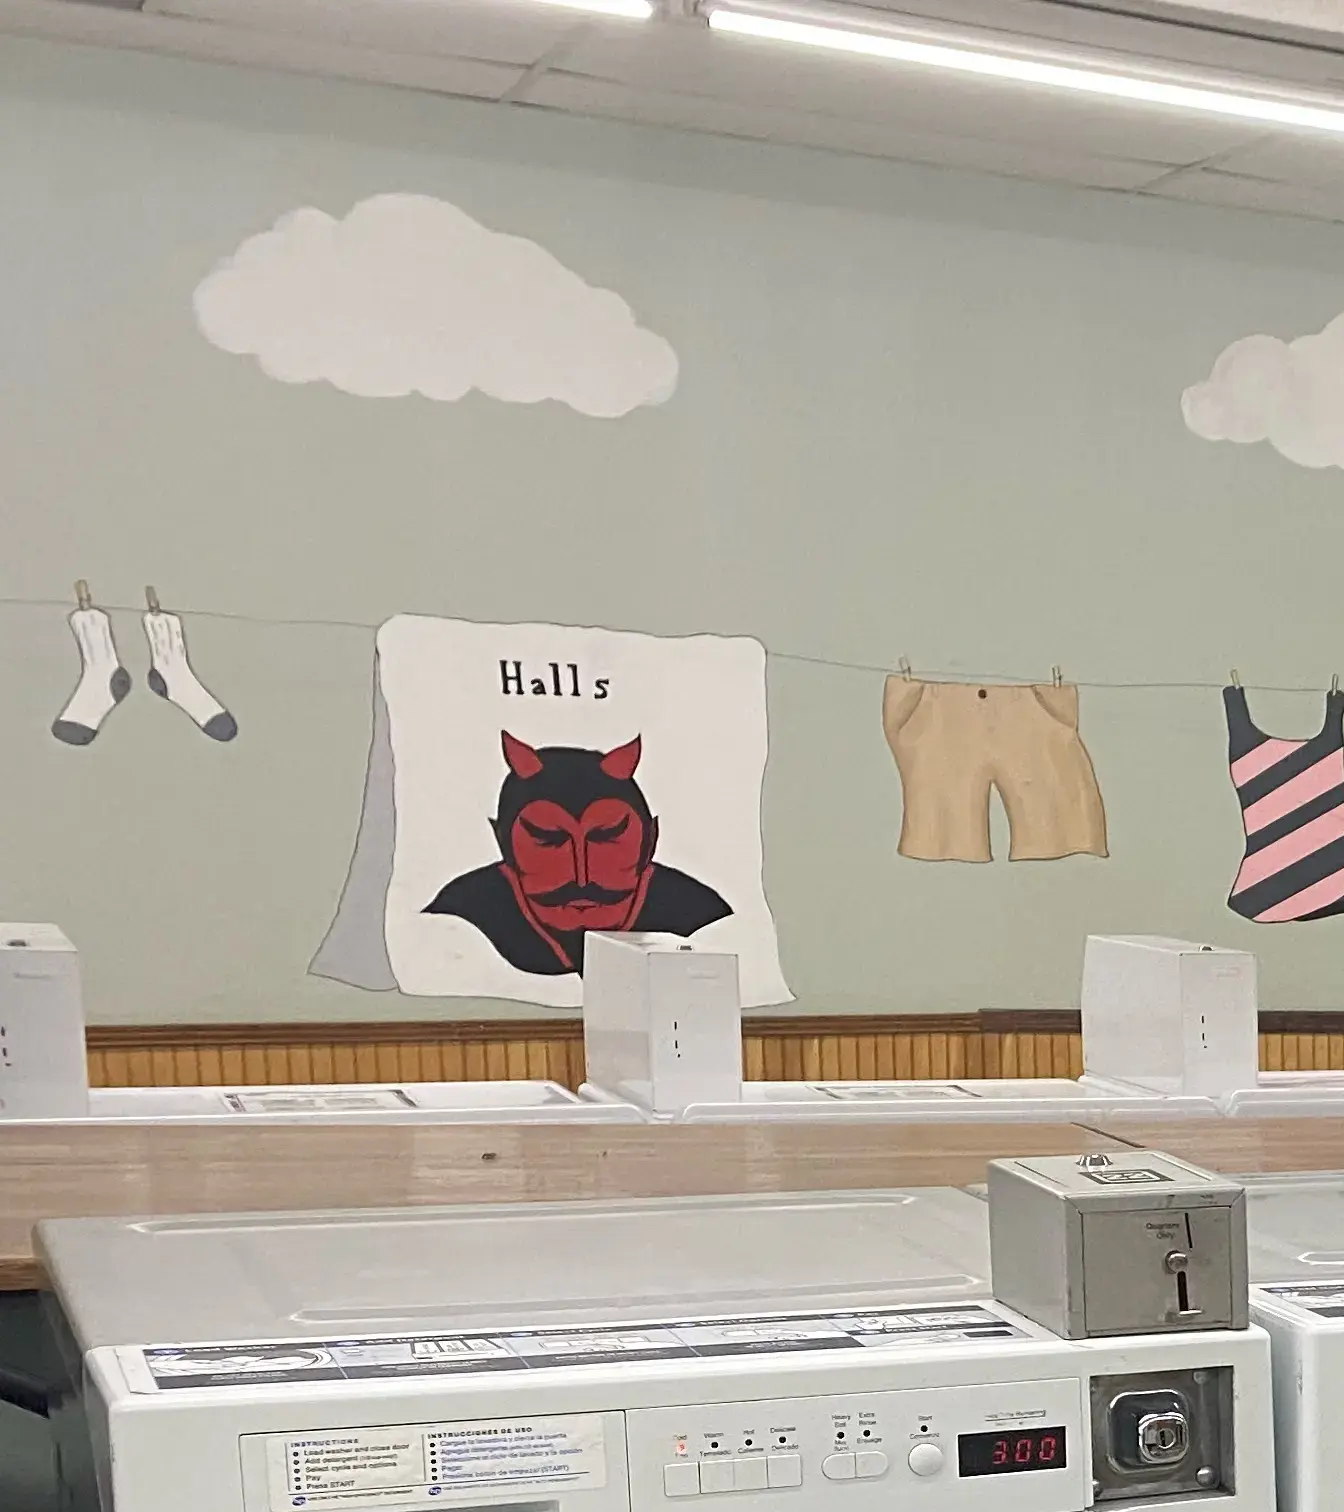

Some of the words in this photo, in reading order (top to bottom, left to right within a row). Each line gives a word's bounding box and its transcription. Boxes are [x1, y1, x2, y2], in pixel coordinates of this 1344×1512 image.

[499, 659, 611, 700] Halls
[427, 1428, 499, 1440] INSTRUCCIONES
[500, 1427, 513, 1435] DE
[515, 1426, 533, 1434] USO
[290, 1438, 359, 1448] INSTRUCTIONS
[991, 1435, 1057, 1465] 300
[305, 1474, 322, 1482] Pay
[306, 1482, 328, 1490] Press
[329, 1480, 356, 1489] START
